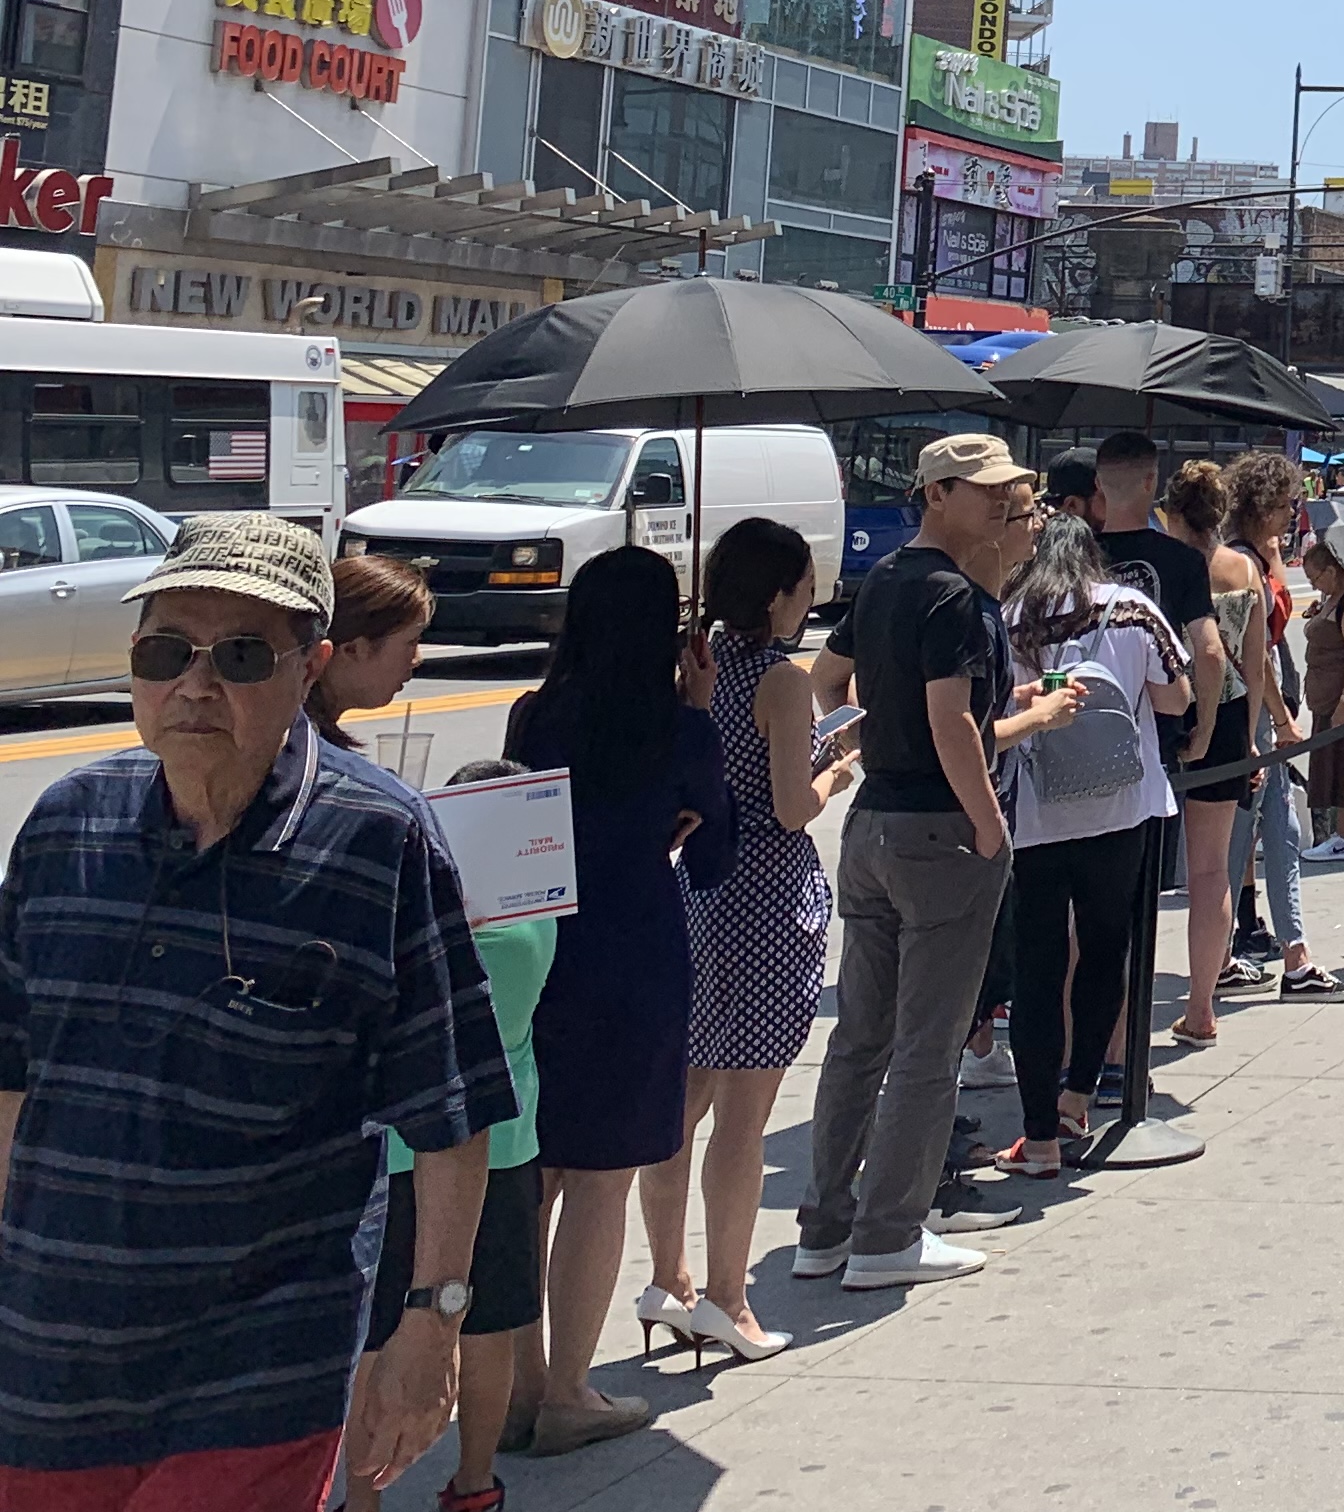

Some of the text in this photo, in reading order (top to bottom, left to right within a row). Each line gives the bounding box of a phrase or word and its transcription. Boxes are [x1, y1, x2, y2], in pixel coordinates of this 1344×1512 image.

[213, 20, 407, 105] FOOD COURT
[943, 71, 985, 115] Nail
[0, 138, 114, 236] ker
[131, 266, 252, 318] NEW
[261, 278, 423, 332] WORLD
[883, 286, 896, 299] 40
[515, 842, 566, 858] PRIORITY
